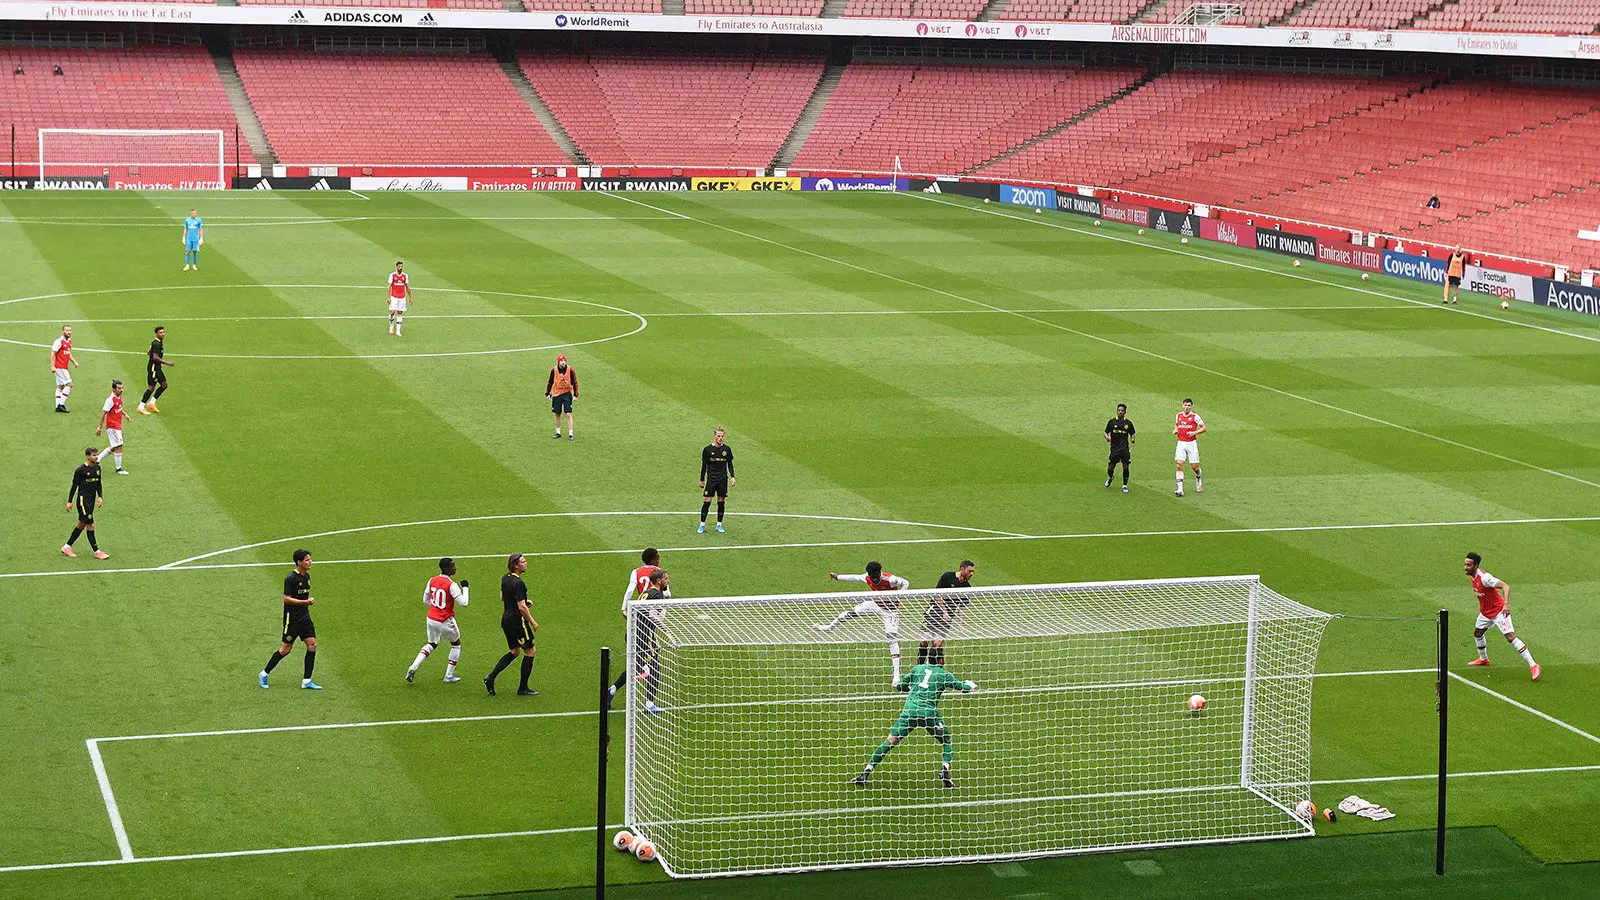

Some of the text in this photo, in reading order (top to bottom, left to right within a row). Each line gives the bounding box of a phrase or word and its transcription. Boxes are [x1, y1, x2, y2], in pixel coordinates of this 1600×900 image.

[51, 6, 192, 19] Fly Emirates to the Far East
[324, 12, 403, 23] ADIDAS.COM
[570, 17, 630, 27] WorldRemit
[698, 20, 823, 31] Fly Emirates to Australasia
[1111, 27, 1207, 43] ARSENALDIRECT.COM
[1457, 37, 1518, 51] Fly Emirates to Dubai
[583, 181, 689, 191] VISIT RWANDA
[1011, 187, 1046, 207] zoom
[1057, 195, 1101, 215] VISIT RWANDA
[1102, 204, 1126, 220] Emirates
[1256, 232, 1316, 257] VISIT RWANDA
[1319, 243, 1380, 269] Emirates FLY BETTER
[1547, 281, 1600, 316] Acroni
[430, 586, 447, 610] 30
[917, 668, 933, 689] 1
